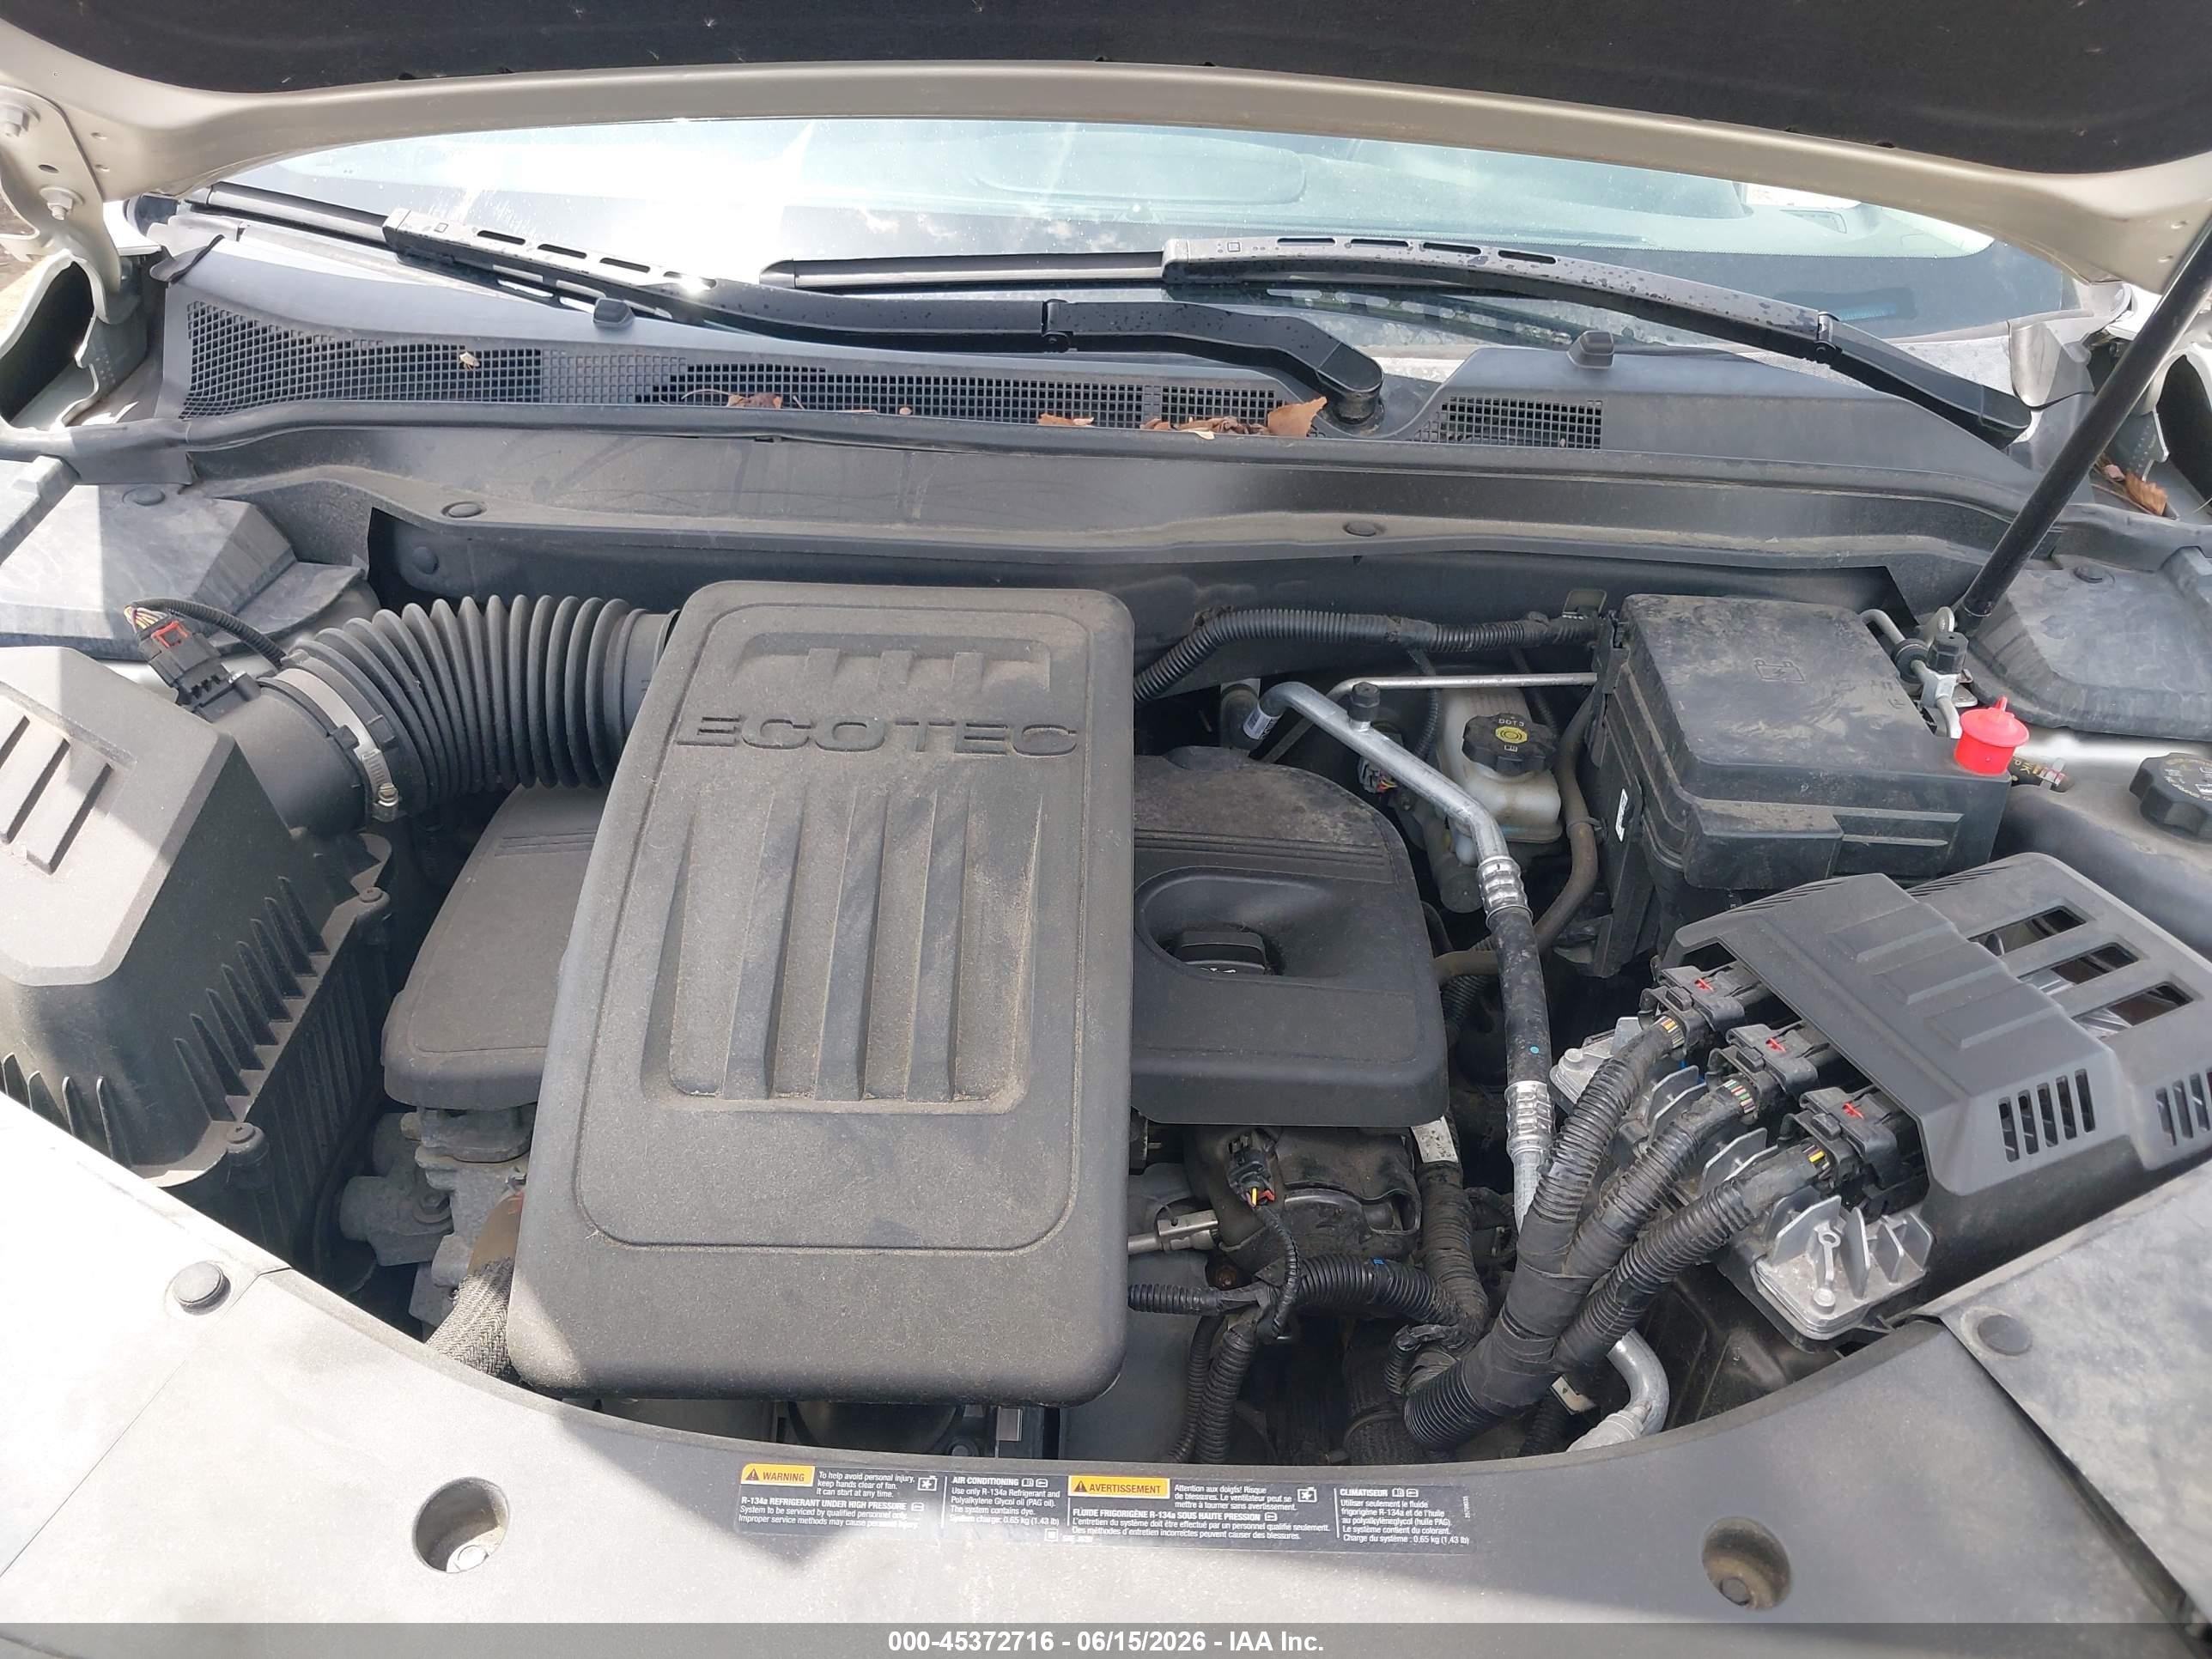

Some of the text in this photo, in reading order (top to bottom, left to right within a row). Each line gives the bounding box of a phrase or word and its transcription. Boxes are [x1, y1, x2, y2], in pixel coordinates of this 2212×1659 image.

[676, 714, 1079, 759] ECOTEC
[763, 1472, 805, 1481] WARNING
[819, 1471, 826, 1480] To
[829, 1472, 842, 1480] help
[817, 1480, 834, 1488] keep
[952, 1476, 1019, 1486] AIR CONDITIONING
[966, 1487, 981, 1496] only
[1008, 1489, 1046, 1498] Refrigerant
[1090, 1484, 1161, 1493] AVERTISSEMENT
[1219, 1486, 1243, 1494] doigts!
[1243, 1486, 1267, 1495] Risque
[1340, 1488, 1388, 1497] CLIMATISEUR
[741, 1497, 769, 1505] R-134a
[769, 1498, 821, 1507] REFRIGERANT
[822, 1499, 847, 1508] UNDER
[868, 1502, 907, 1510] PRESSURE
[951, 1496, 993, 1505] Polyalkylene
[994, 1498, 1015, 1506] Glycol
[1043, 1499, 1056, 1508] oil).
[740, 1504, 765, 1515] System
[817, 1508, 825, 1517] by
[827, 1509, 855, 1517] qualified
[857, 1510, 890, 1519] personnel
[964, 1506, 989, 1515] system
[738, 1514, 769, 1523] Improper
[798, 1516, 828, 1525] methods
[1020, 1516, 1030, 1525] kg
[1030, 1517, 1049, 1526] (1.43
[1120, 1519, 1148, 1528] système
[1343, 1534, 1368, 1543] Charge
[1431, 1536, 1440, 1545] kg
[1460, 1536, 1469, 1545] lb)
